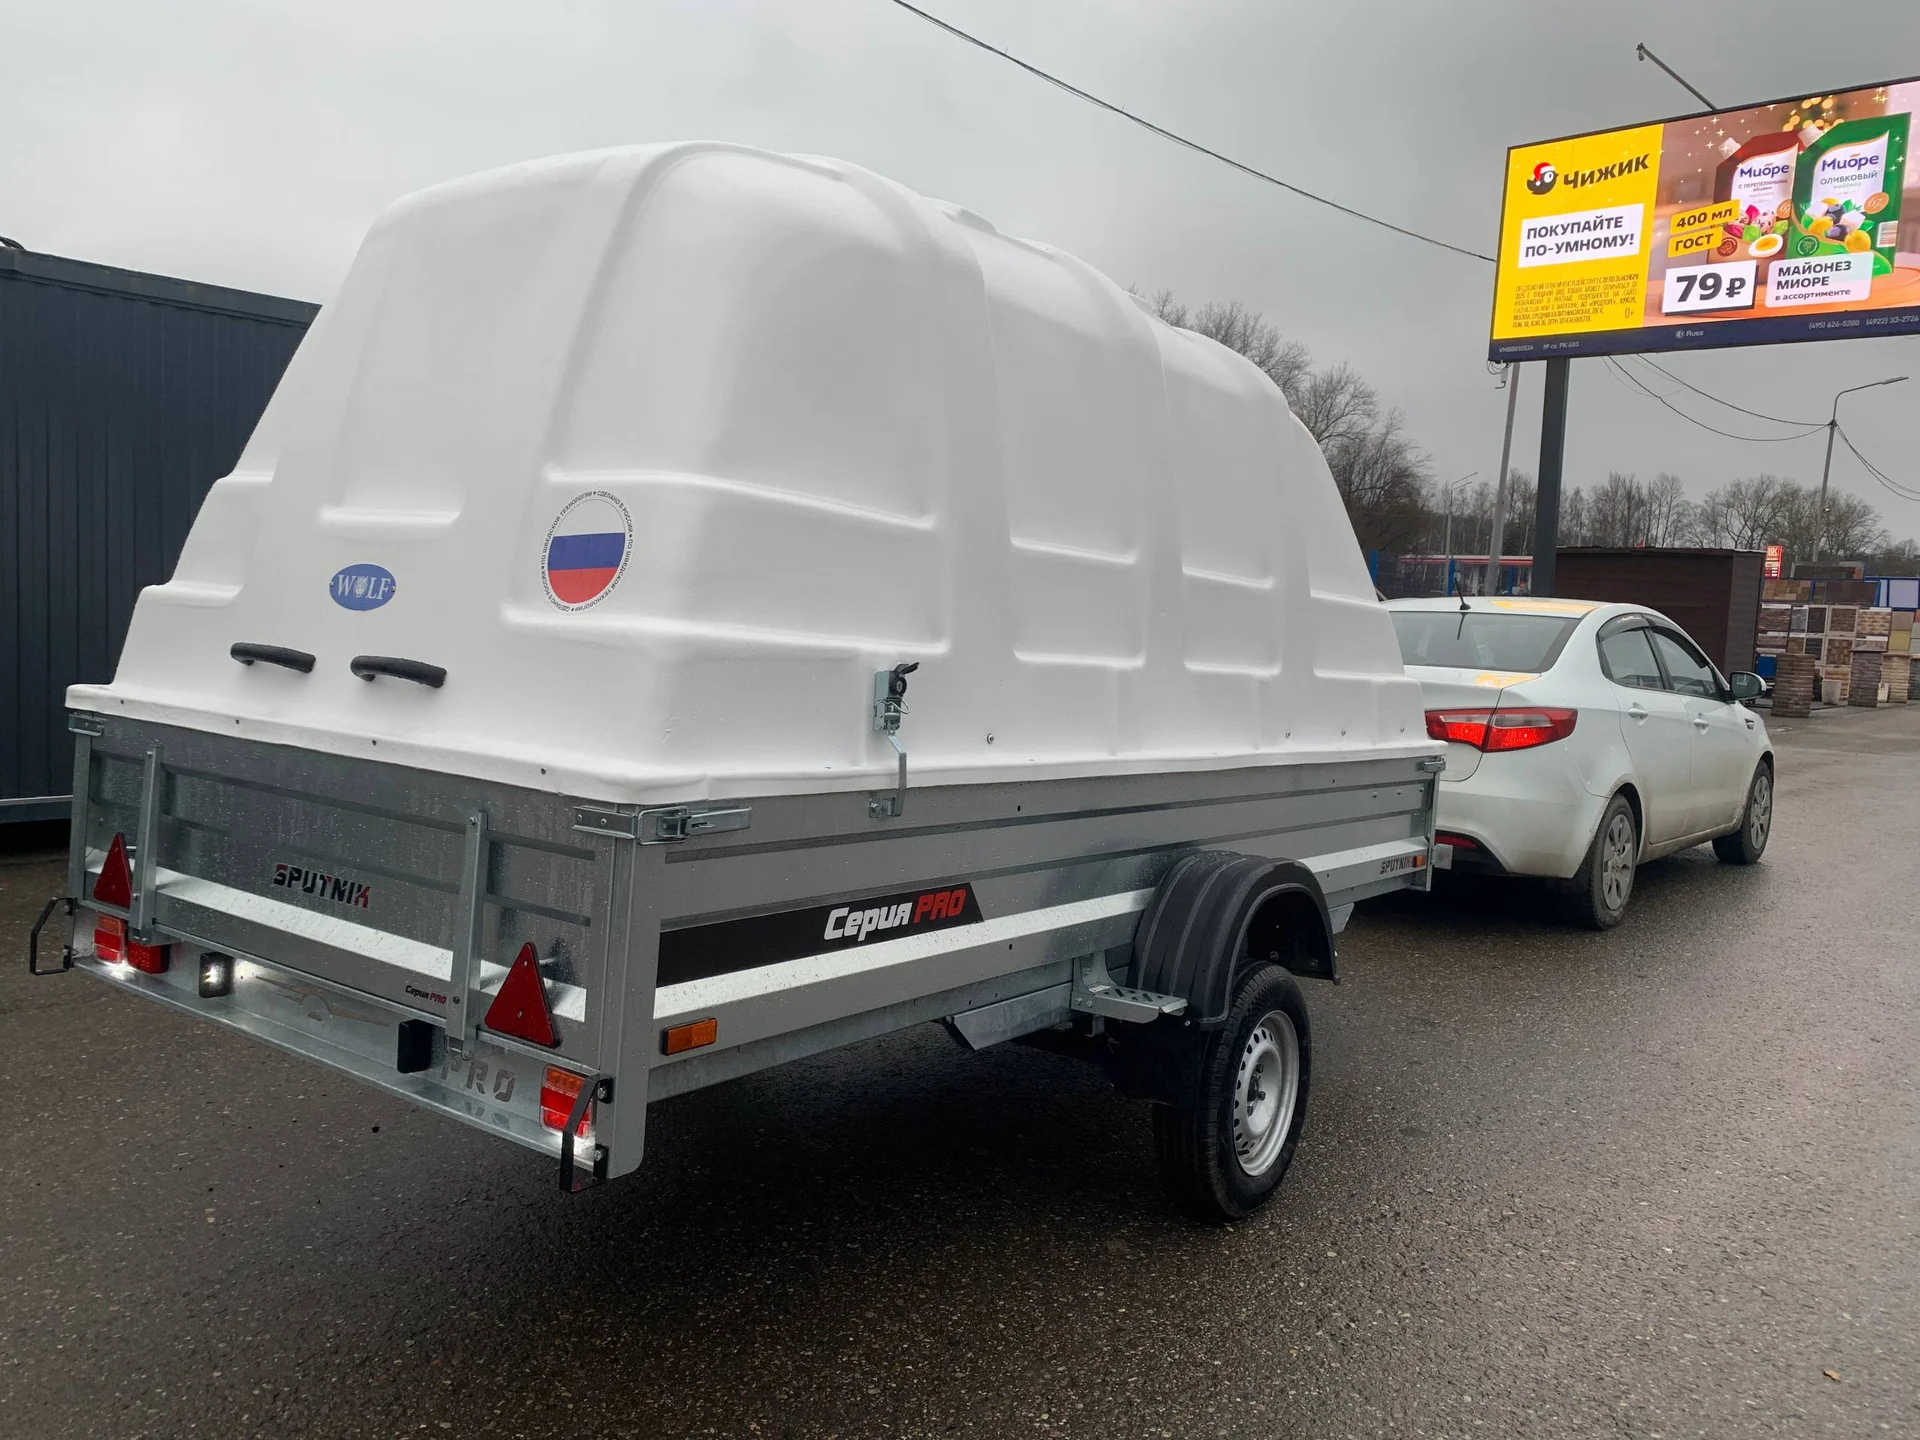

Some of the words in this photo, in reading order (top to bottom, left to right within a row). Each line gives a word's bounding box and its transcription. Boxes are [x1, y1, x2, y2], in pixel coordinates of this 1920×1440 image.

[1563, 153, 1650, 189] ЧИЖИК
[1740, 162, 1790, 178] Миоре
[1821, 154, 1880, 172] Миоре
[1820, 170, 1878, 186] ОЛИВКОВЫЙ
[1526, 215, 1624, 240] ПОКУПАЙТЕ
[1676, 212, 1708, 228] 400
[1711, 208, 1732, 220] мл
[1525, 233, 1634, 258] ПО-УМНОМУ!
[1674, 233, 1714, 252] ГОСТ
[1778, 260, 1852, 277] МАЙОНЕЗ
[1776, 276, 1830, 290] МИОРЕ
[1782, 289, 1851, 301] ассортименте
[622, 507, 633, 532] РОССИИ
[1380, 856, 1412, 874] SPUTNIK
[274, 864, 371, 909] SPUTNIK
[824, 902, 913, 942] Серия
[912, 888, 967, 924] PRO
[405, 985, 430, 999] Серия
[430, 992, 447, 1004] PRO
[441, 1056, 516, 1102] PRO
